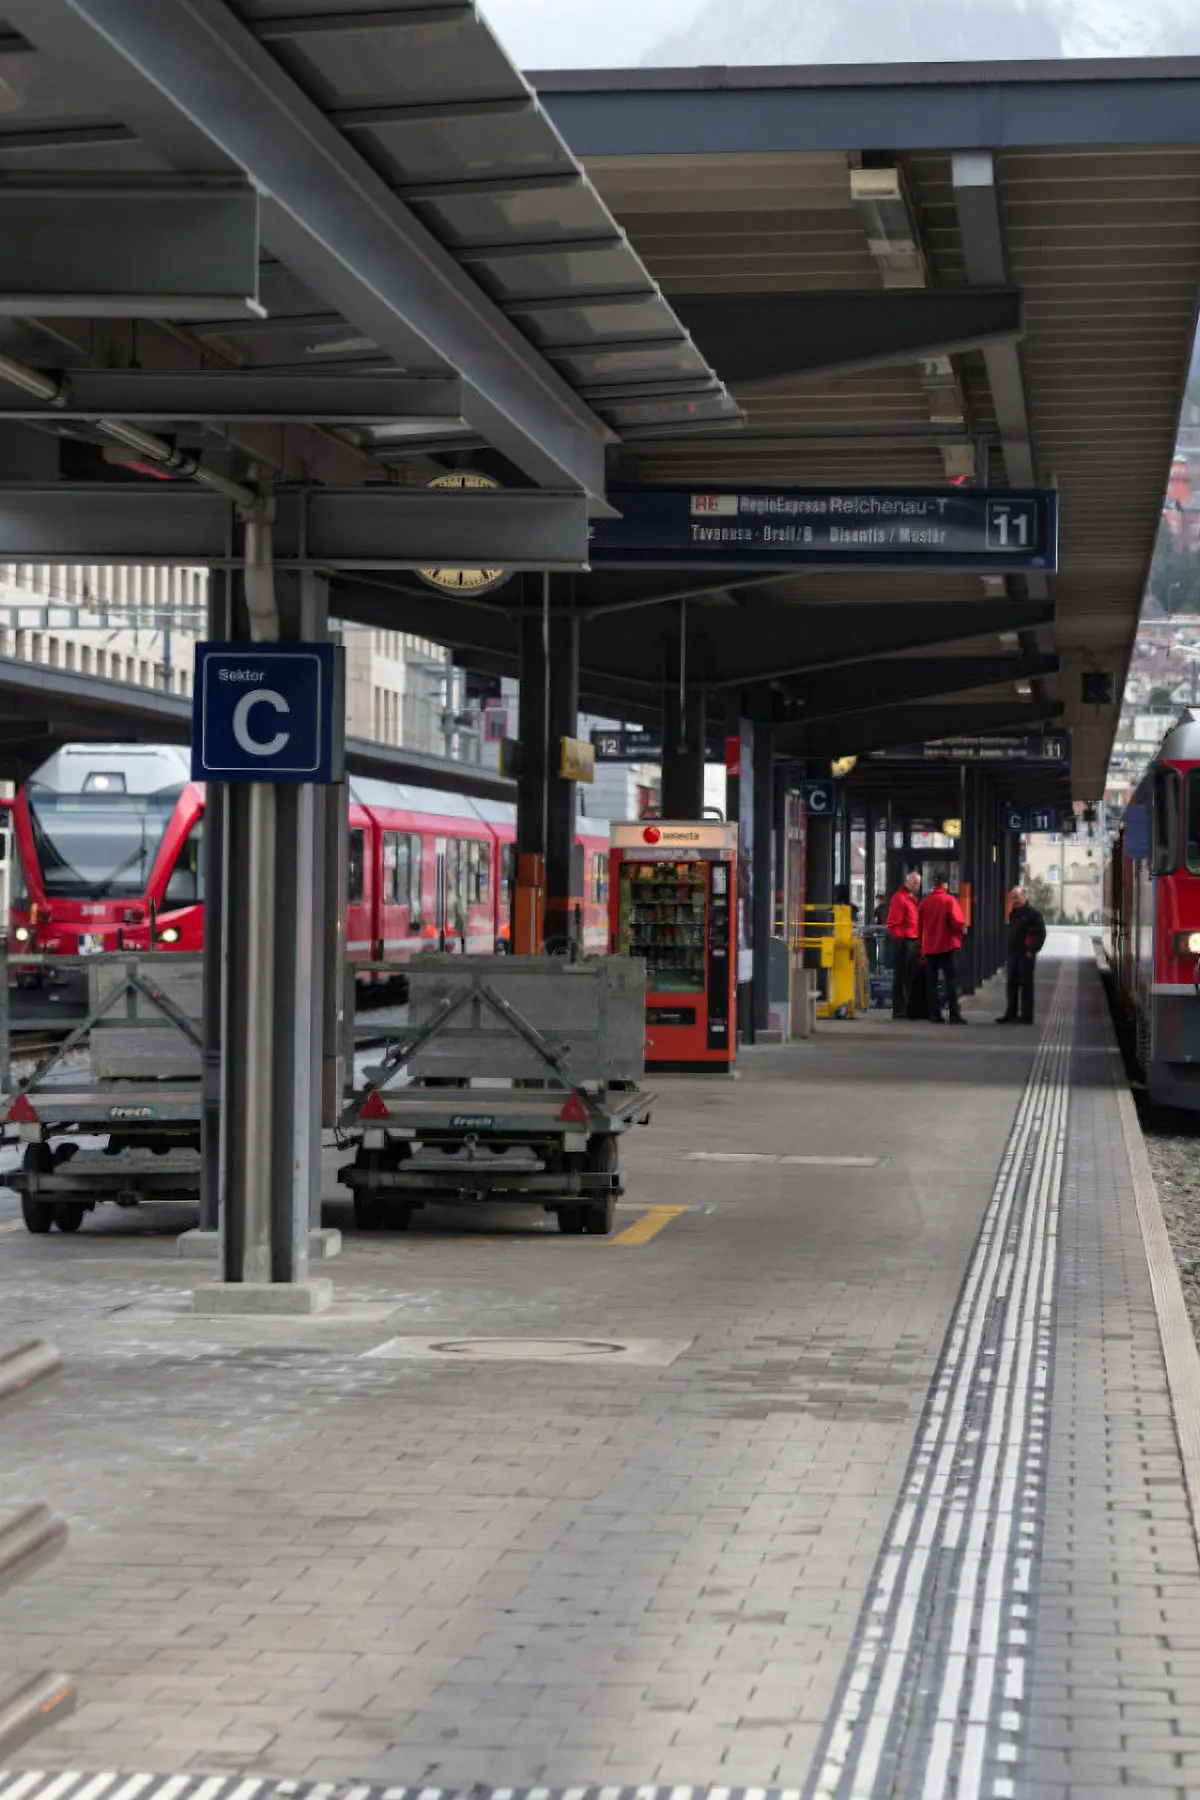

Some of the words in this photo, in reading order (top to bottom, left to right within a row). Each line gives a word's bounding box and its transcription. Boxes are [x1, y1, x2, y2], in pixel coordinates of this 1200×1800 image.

[695, 496, 719, 512] RE
[993, 513, 1028, 545] 11
[217, 668, 266, 681] Sektor
[232, 688, 290, 755] C
[599, 739, 617, 753] 12
[809, 789, 827, 811] C
